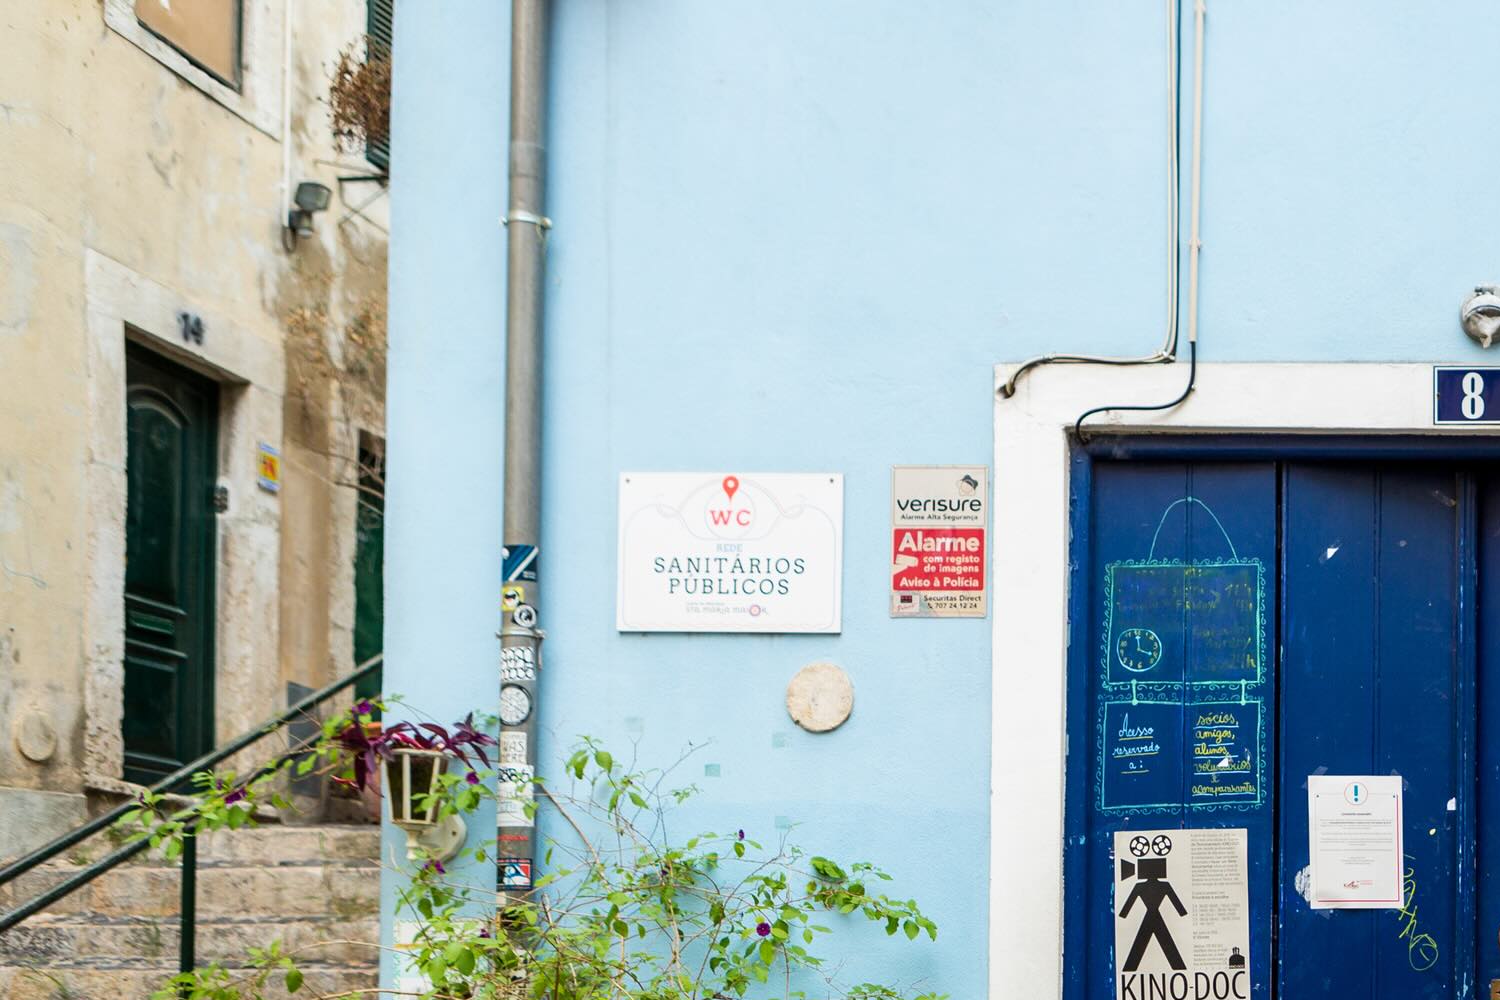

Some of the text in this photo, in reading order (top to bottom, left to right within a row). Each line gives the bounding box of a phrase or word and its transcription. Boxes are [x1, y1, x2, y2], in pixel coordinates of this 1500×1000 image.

[1461, 371, 1485, 420] 8
[897, 498, 982, 512] verisure
[943, 514, 978, 522] Segurança
[898, 531, 981, 553] Alarme
[653, 553, 806, 575] SANITÁRIOS
[923, 555, 981, 566] com registo
[924, 565, 980, 575] de imagens
[669, 572, 790, 595] PÚBLICOS
[900, 577, 980, 588] Aviso à Polícia
[1118, 713, 1154, 738] Acesso
[1195, 730, 1235, 745] amigos,
[1112, 744, 1160, 756] reservado
